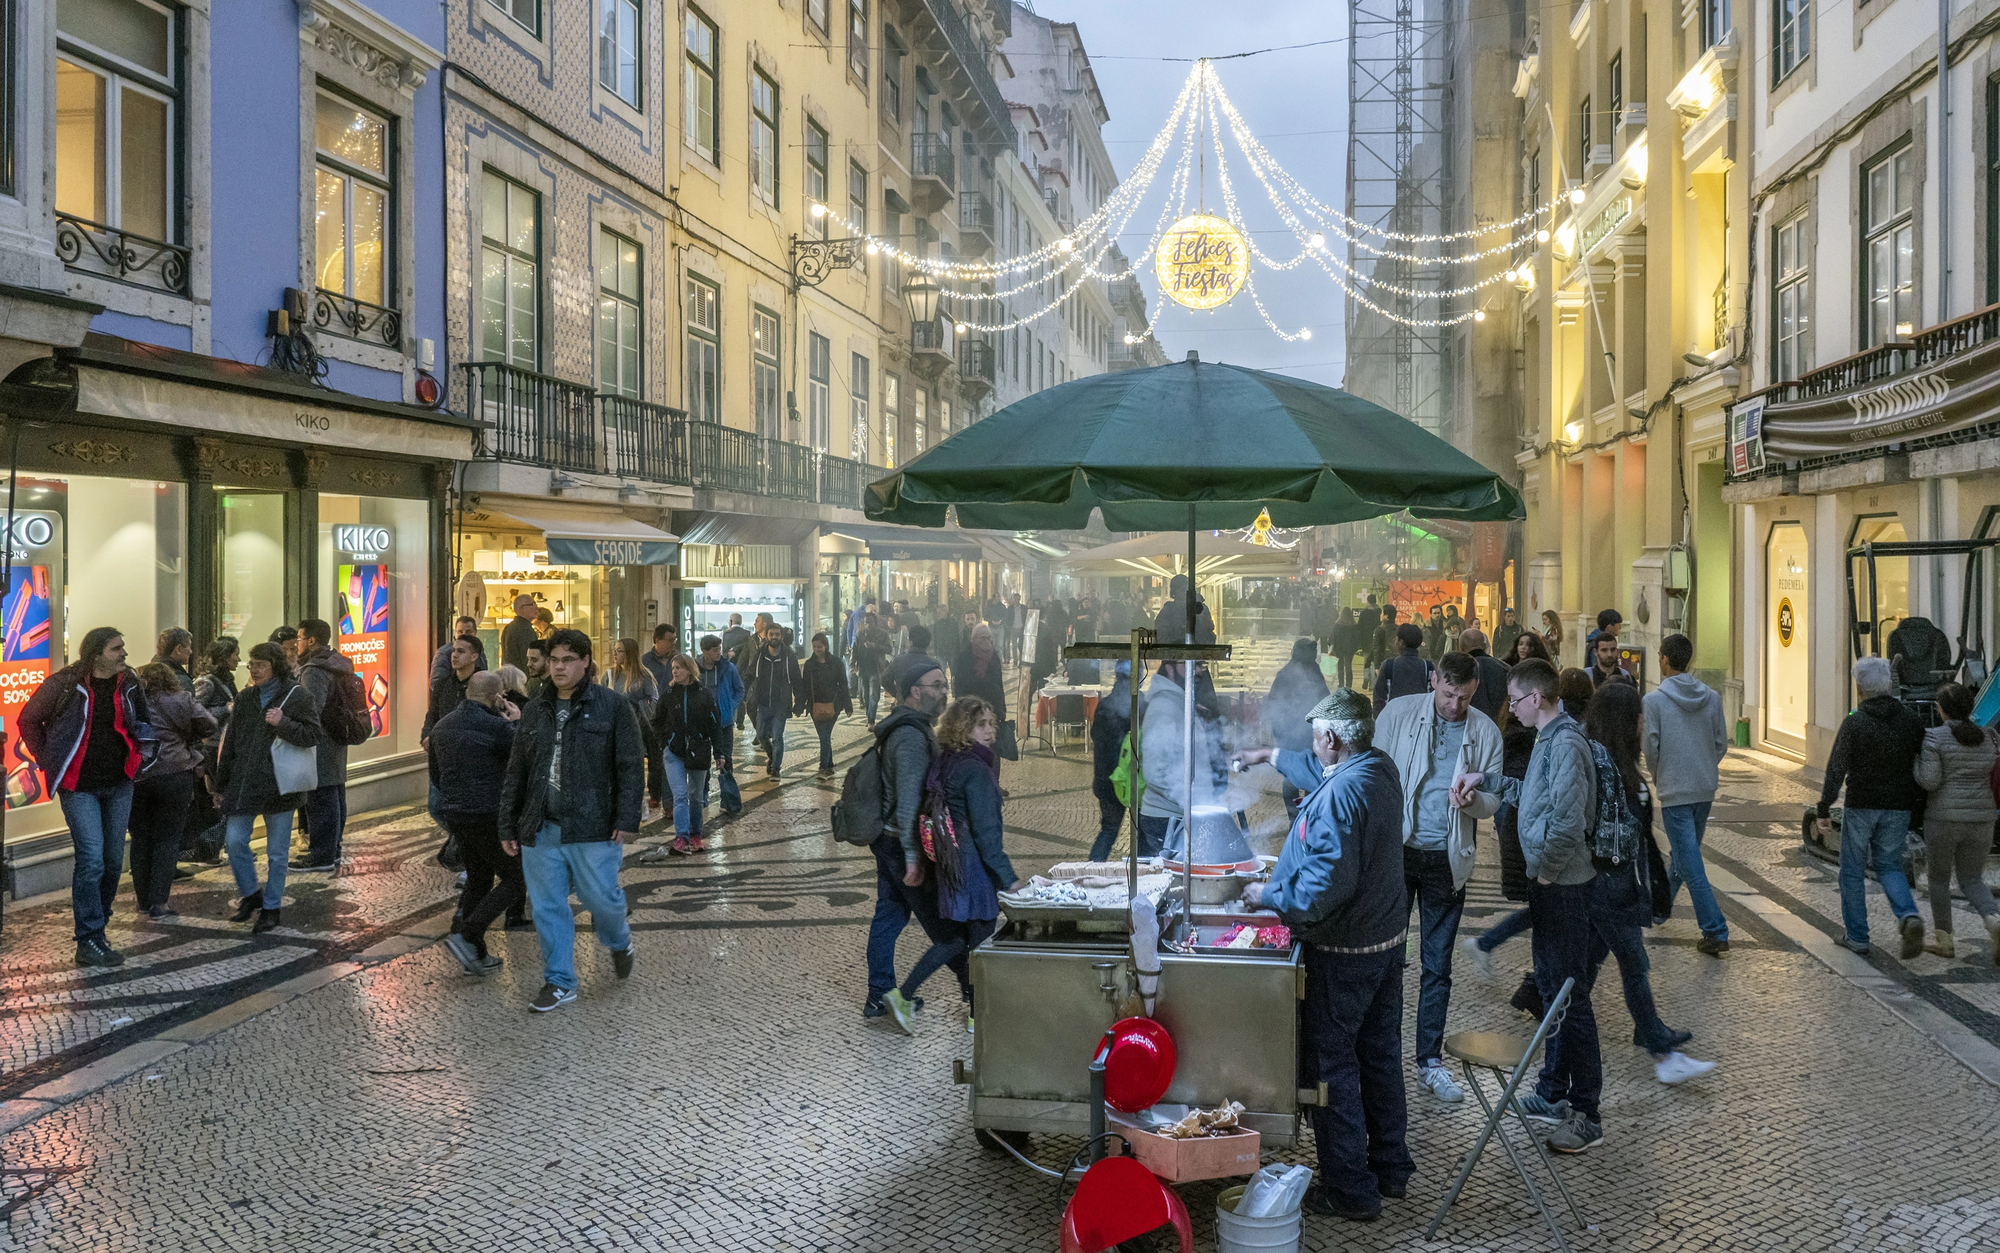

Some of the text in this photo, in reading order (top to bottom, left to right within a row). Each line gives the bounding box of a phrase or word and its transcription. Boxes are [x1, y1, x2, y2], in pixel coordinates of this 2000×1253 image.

[1172, 231, 1238, 266] Felices
[1172, 261, 1238, 297] Fiestas
[295, 413, 330, 431] KIKO
[1874, 421, 1906, 437] LANDMARK
[1904, 418, 1922, 431] REAL
[1921, 411, 1946, 427] ESTATE
[338, 528, 390, 551] KIKO
[594, 538, 643, 566] SEASIDE
[340, 637, 386, 654] PROMOÇÕES
[348, 652, 362, 665] TÉ
